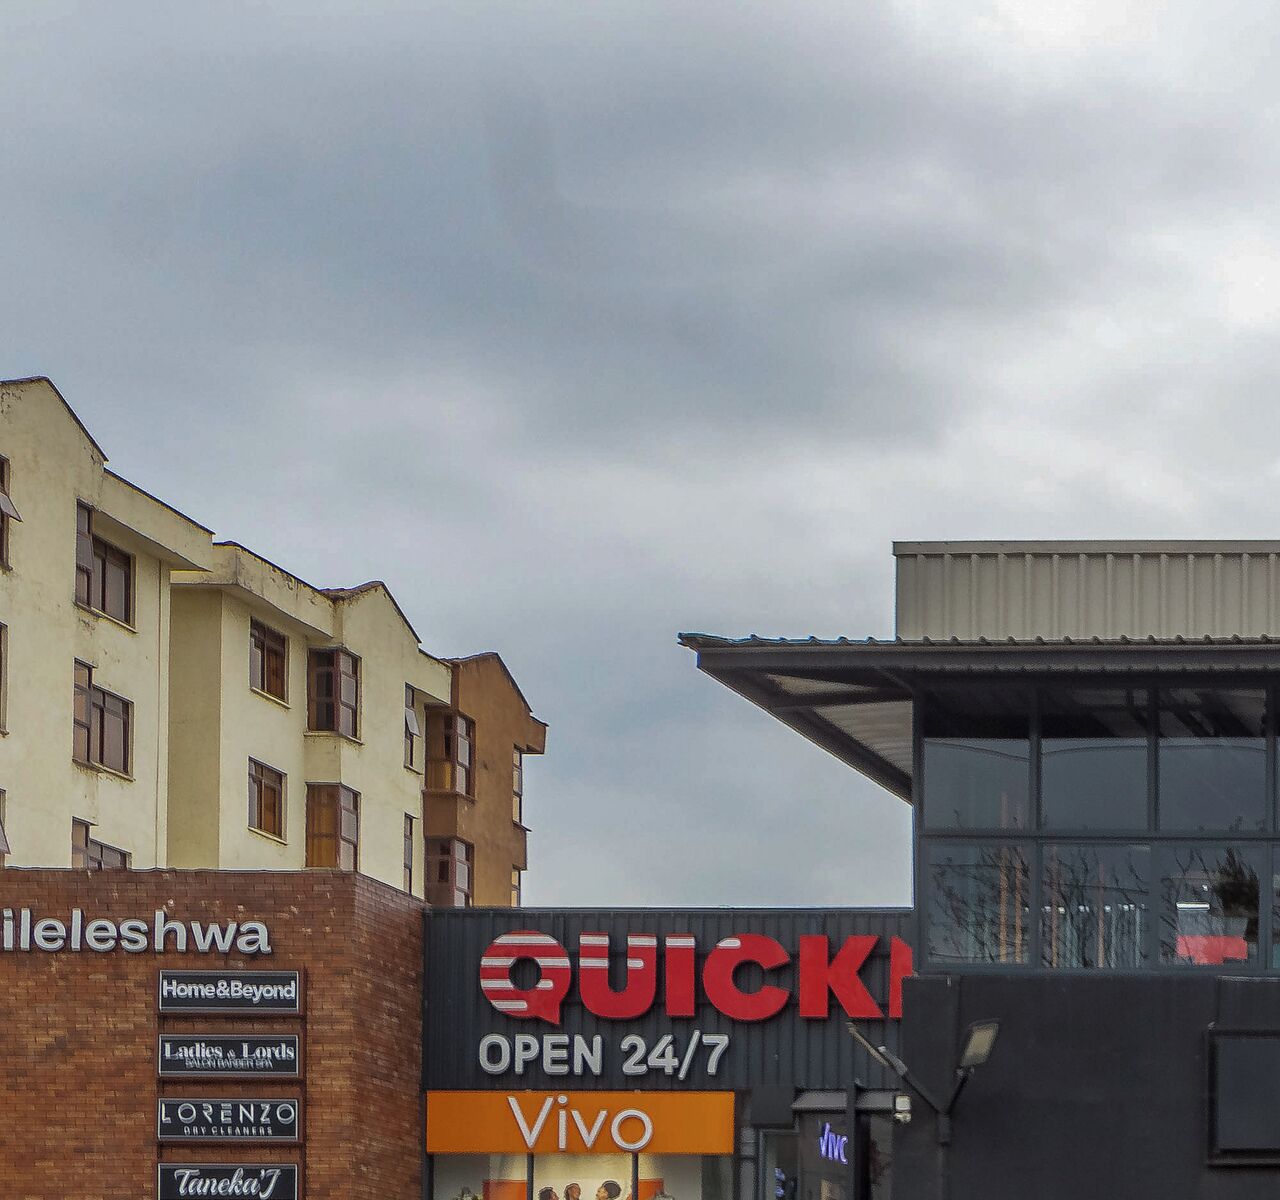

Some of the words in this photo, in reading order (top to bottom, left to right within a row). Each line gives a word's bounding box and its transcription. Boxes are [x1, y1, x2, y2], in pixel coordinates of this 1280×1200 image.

[2, 907, 272, 954] ileleshwa
[162, 979, 296, 1003] Home&Beyond
[480, 930, 913, 1024] QUICK
[164, 1042, 222, 1060] Ladies
[242, 1042, 295, 1061] Lords
[479, 1033, 603, 1076] OPEN
[620, 1030, 730, 1080] 24/7
[161, 1103, 295, 1124] LORENZO
[184, 1126, 206, 1136] DRY
[211, 1126, 273, 1136] CLEANERS
[507, 1094, 654, 1152] Vivo
